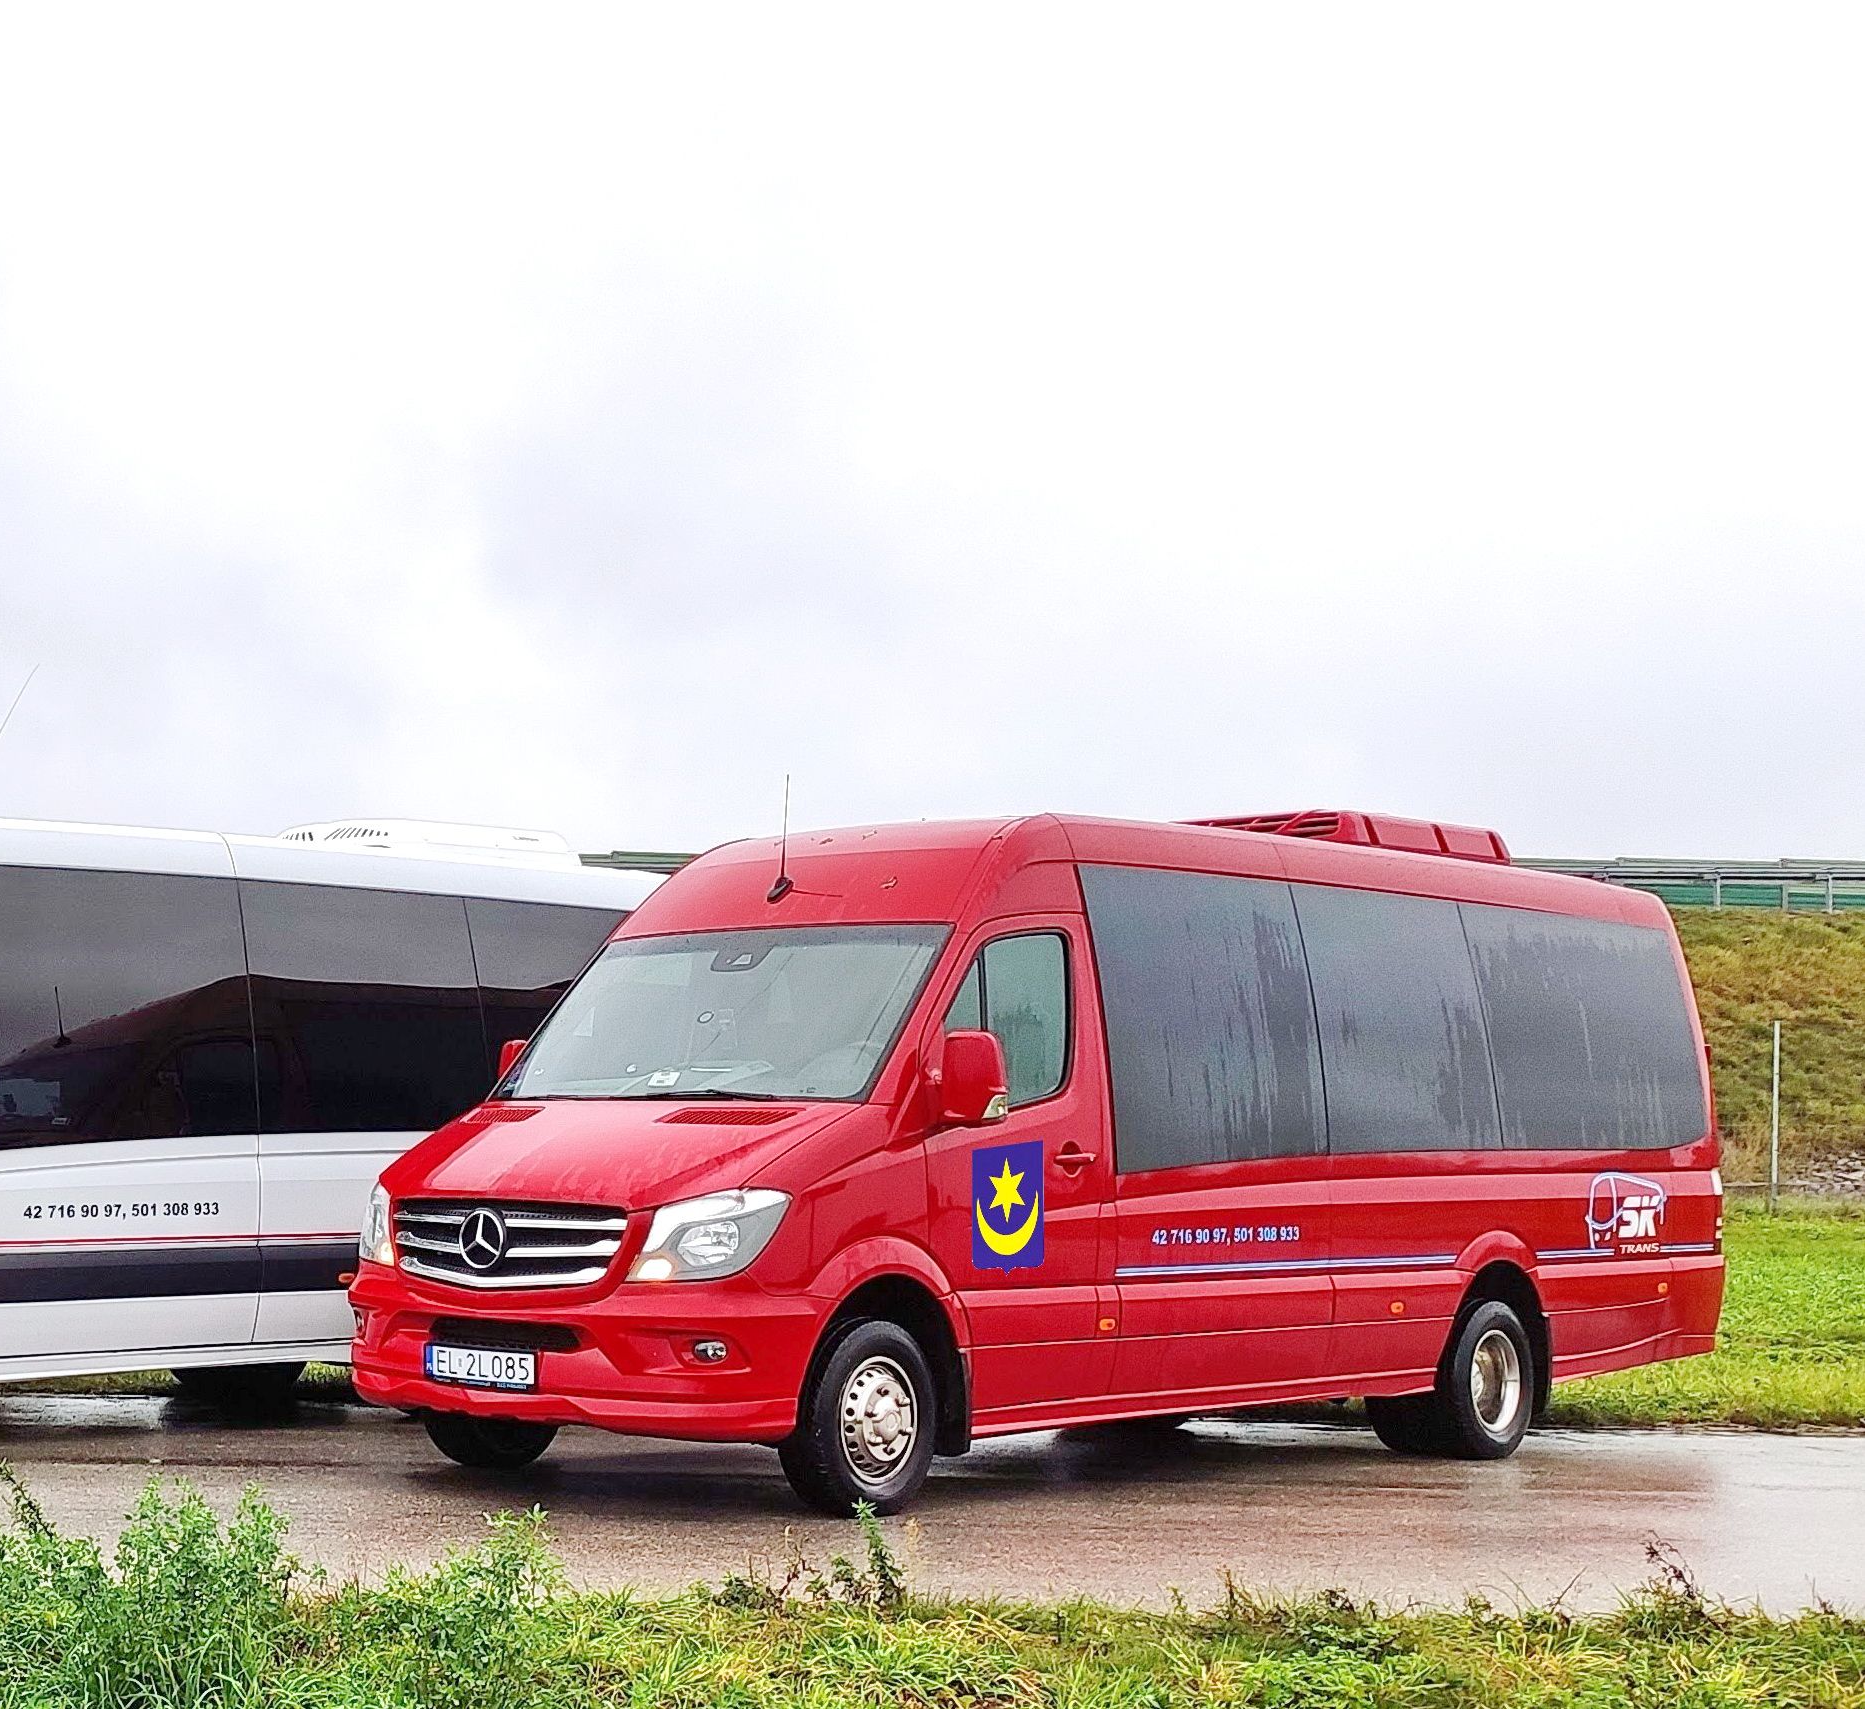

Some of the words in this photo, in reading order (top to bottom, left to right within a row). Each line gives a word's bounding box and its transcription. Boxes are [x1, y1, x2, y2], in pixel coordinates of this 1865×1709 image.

[23, 1205, 42, 1219] 42
[48, 1204, 75, 1218] 716
[81, 1204, 99, 1218] 90
[104, 1203, 127, 1220] 97,
[131, 1203, 157, 1217] 501
[163, 1202, 189, 1216] 308
[194, 1202, 220, 1216] 933
[1618, 1195, 1660, 1238] SK
[1152, 1229, 1168, 1245] 42
[1170, 1229, 1193, 1244] 716
[1195, 1228, 1210, 1244] 90
[1212, 1228, 1231, 1246] 97,
[1233, 1227, 1253, 1242] 501
[1257, 1226, 1277, 1242] 308
[1279, 1226, 1300, 1241] 933
[1619, 1242, 1660, 1255] TRANS
[436, 1349, 458, 1375] EL
[466, 1353, 530, 1381] 2L085
